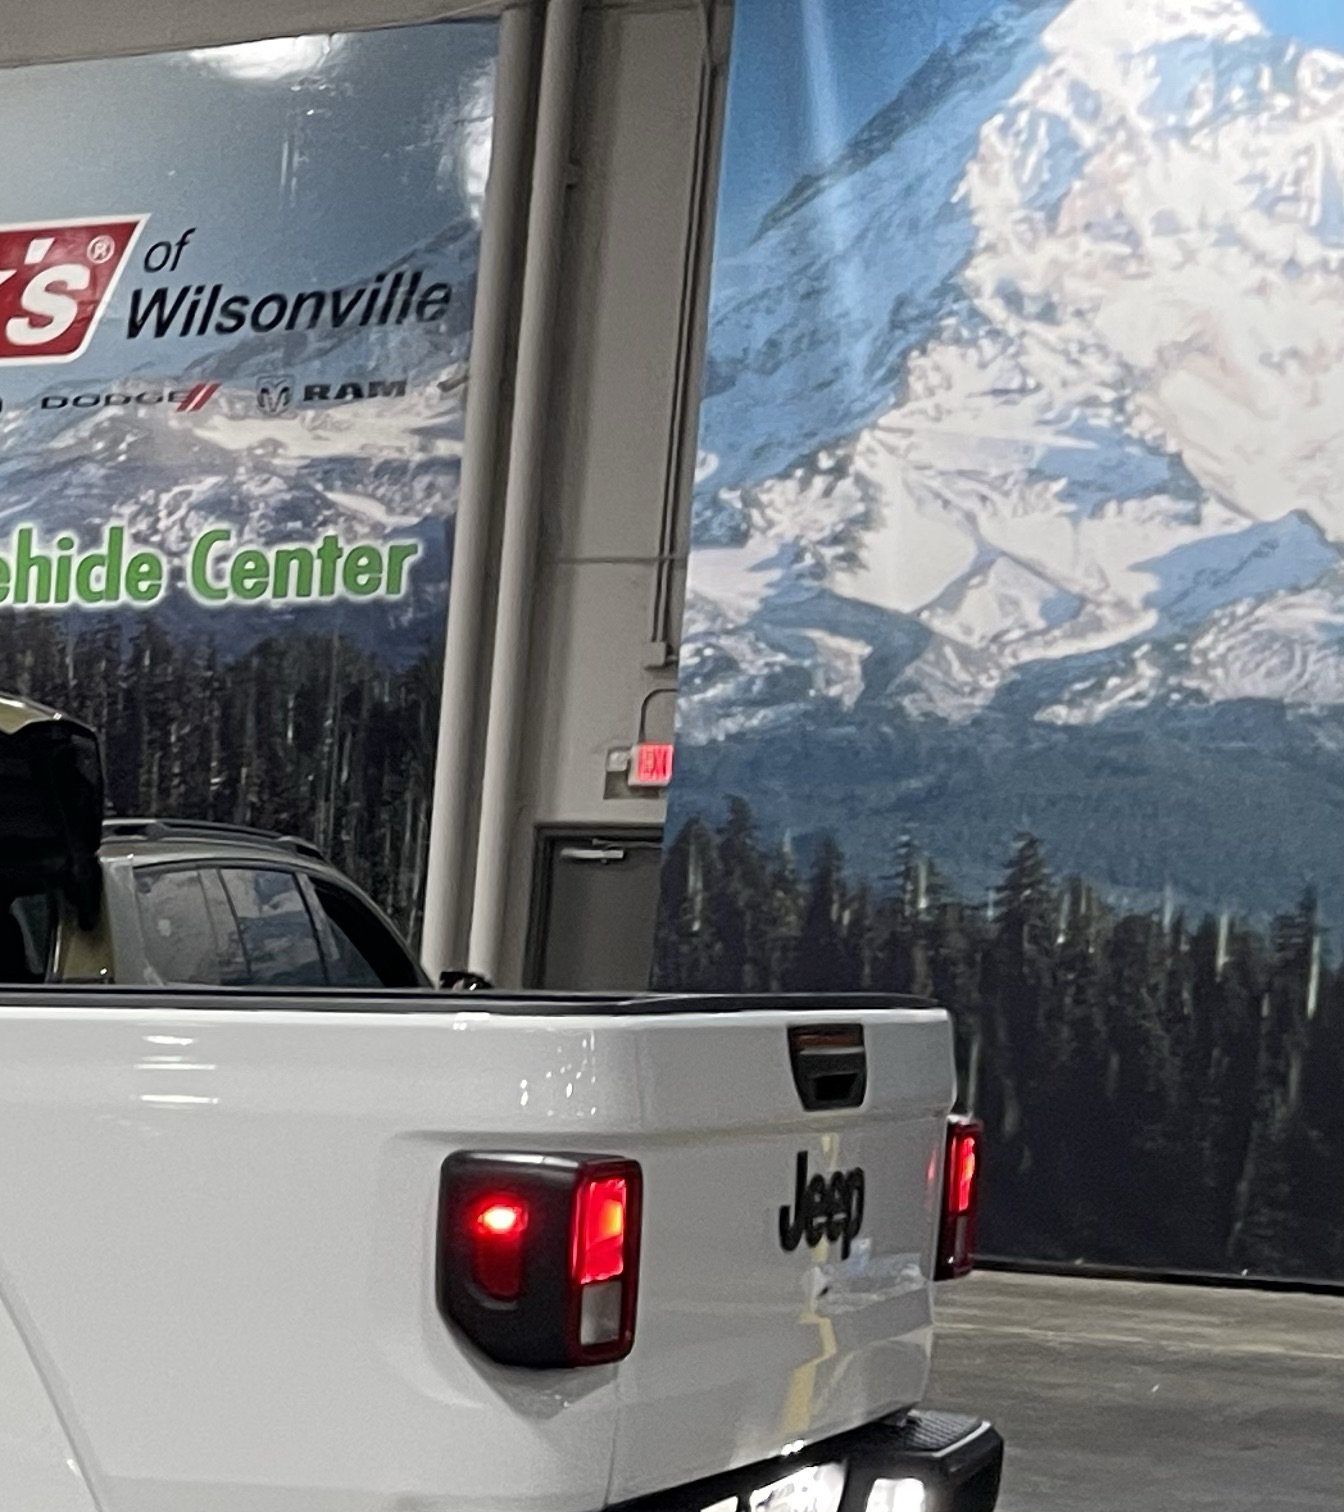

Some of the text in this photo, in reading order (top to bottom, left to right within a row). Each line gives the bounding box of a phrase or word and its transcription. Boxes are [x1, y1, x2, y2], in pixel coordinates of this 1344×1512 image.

[142, 228, 198, 275] of
[126, 270, 454, 341] Wilsonville
[303, 378, 408, 403] RAM
[190, 528, 420, 601] Center
[778, 1150, 866, 1260] Jeep
